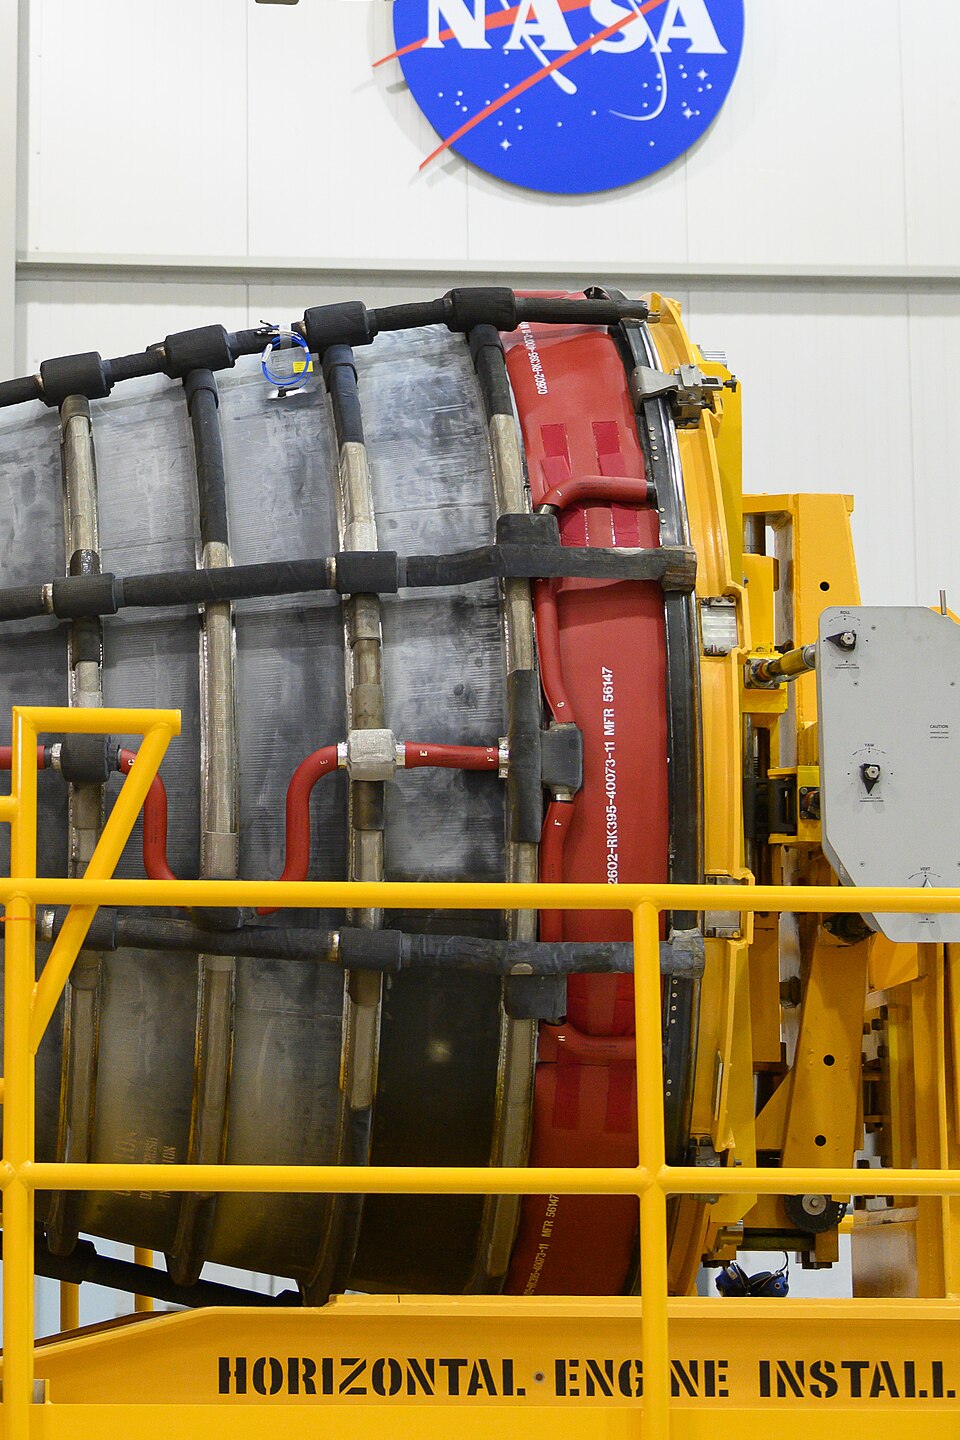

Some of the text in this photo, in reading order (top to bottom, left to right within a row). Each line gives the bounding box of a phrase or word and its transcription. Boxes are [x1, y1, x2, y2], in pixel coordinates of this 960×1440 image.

[601, 666, 613, 702] 56147
[603, 708, 615, 736] MFR
[545, 1194, 560, 1218] 56147
[541, 1220, 554, 1238] MFR
[218, 1357, 956, 1399] HORIZONTAL ENGNE INSTALL
